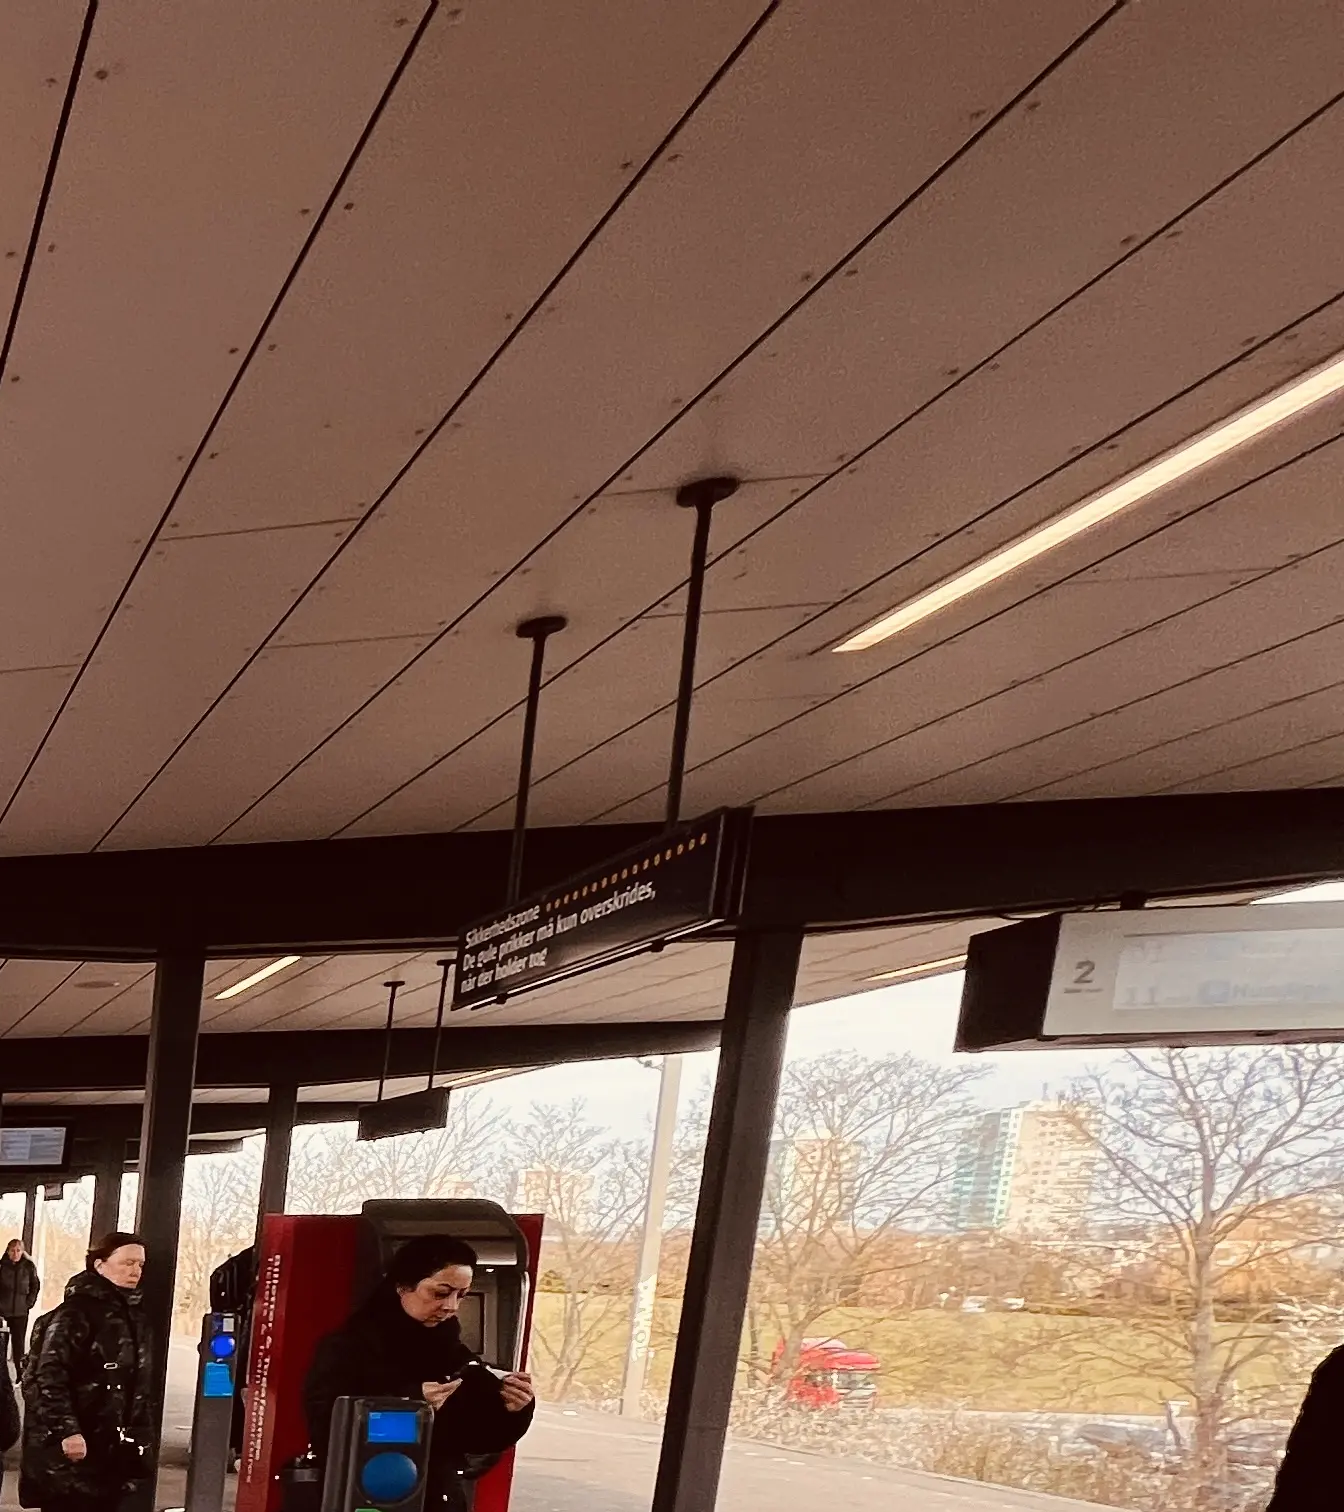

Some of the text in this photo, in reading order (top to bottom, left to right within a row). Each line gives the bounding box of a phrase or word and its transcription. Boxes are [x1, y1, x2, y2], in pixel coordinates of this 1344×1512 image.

[555, 914, 578, 934] kun
[580, 881, 656, 924] overskrides,
[1073, 960, 1095, 984] 2
